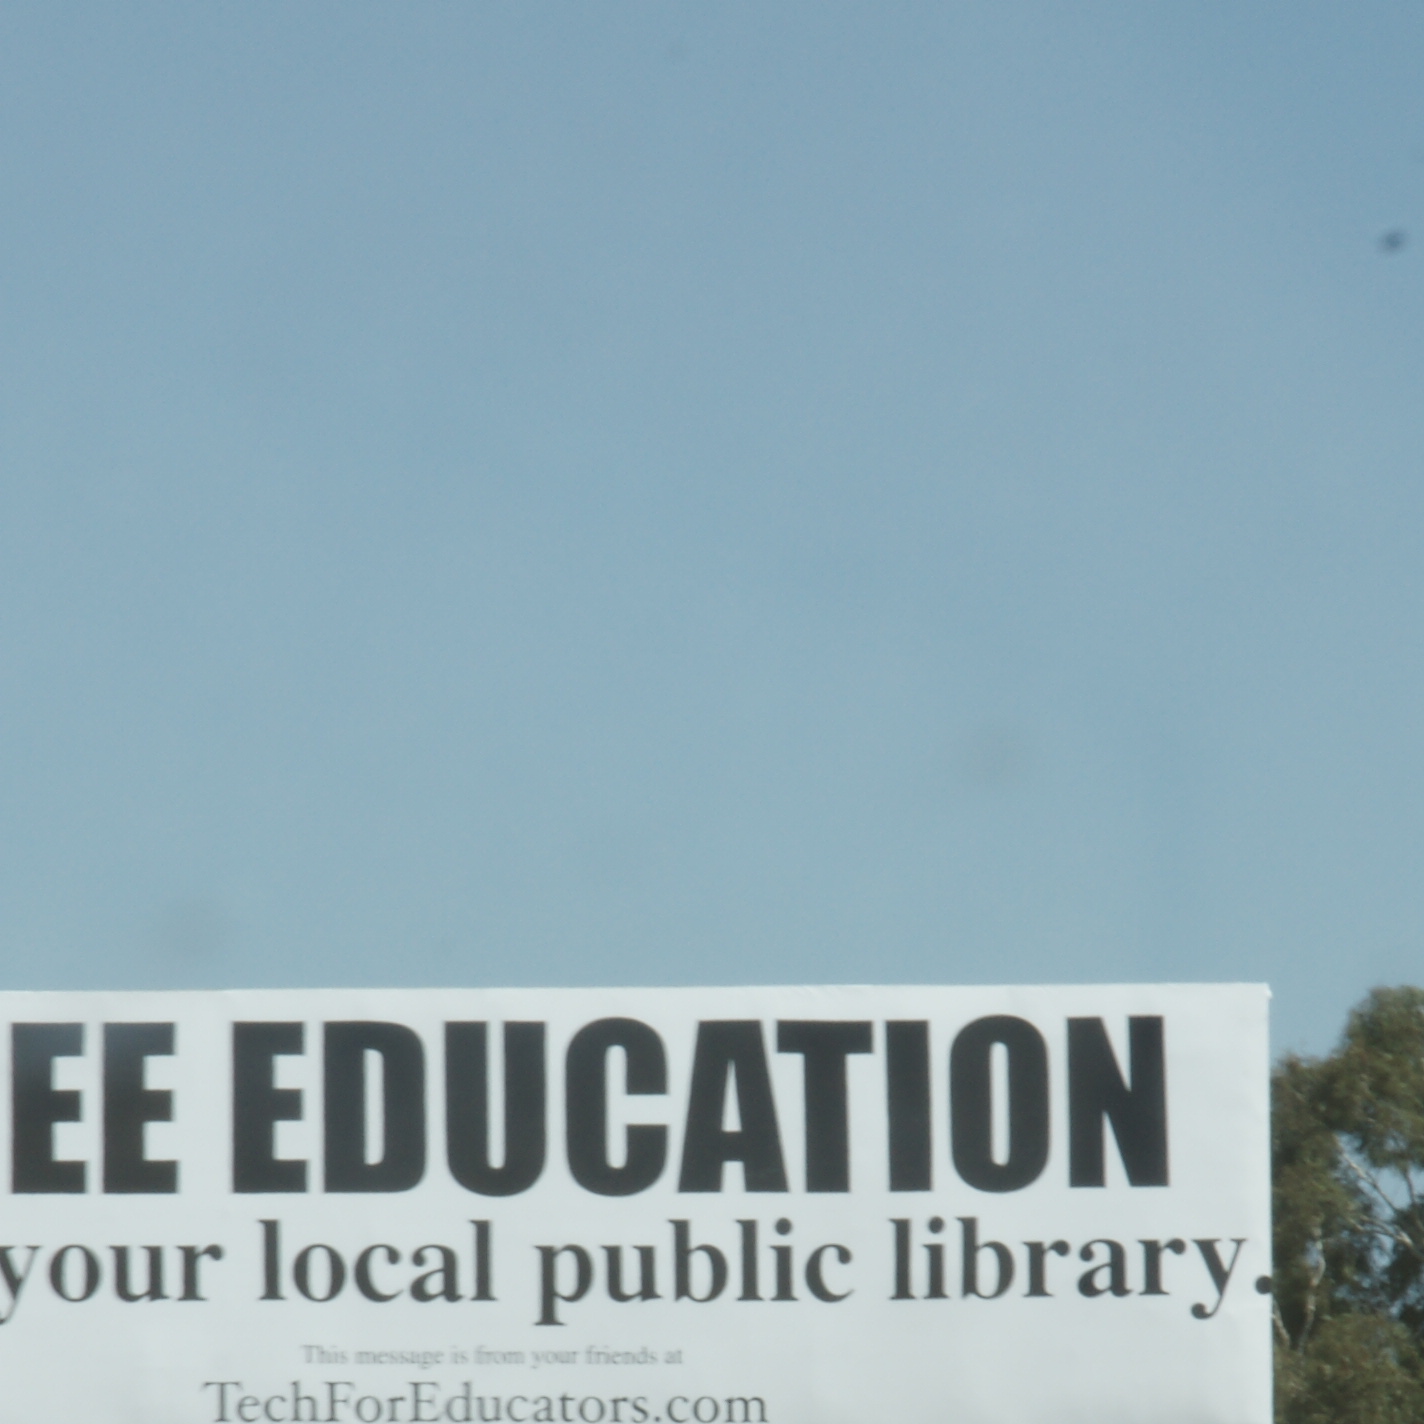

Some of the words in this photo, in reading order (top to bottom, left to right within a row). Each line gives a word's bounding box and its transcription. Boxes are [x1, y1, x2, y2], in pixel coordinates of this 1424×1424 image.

[231, 1014, 1171, 1197] EDUCATION
[257, 1217, 494, 1304] local
[533, 1216, 854, 1326] public
[888, 1215, 1274, 1320] library.
[300, 1344, 348, 1365] This
[353, 1349, 444, 1370] message
[449, 1344, 468, 1365] is
[474, 1344, 526, 1365] from
[529, 1349, 579, 1370] your
[584, 1344, 659, 1365] friends
[663, 1347, 684, 1365] at
[202, 1378, 768, 1424] TechForEducators.com
